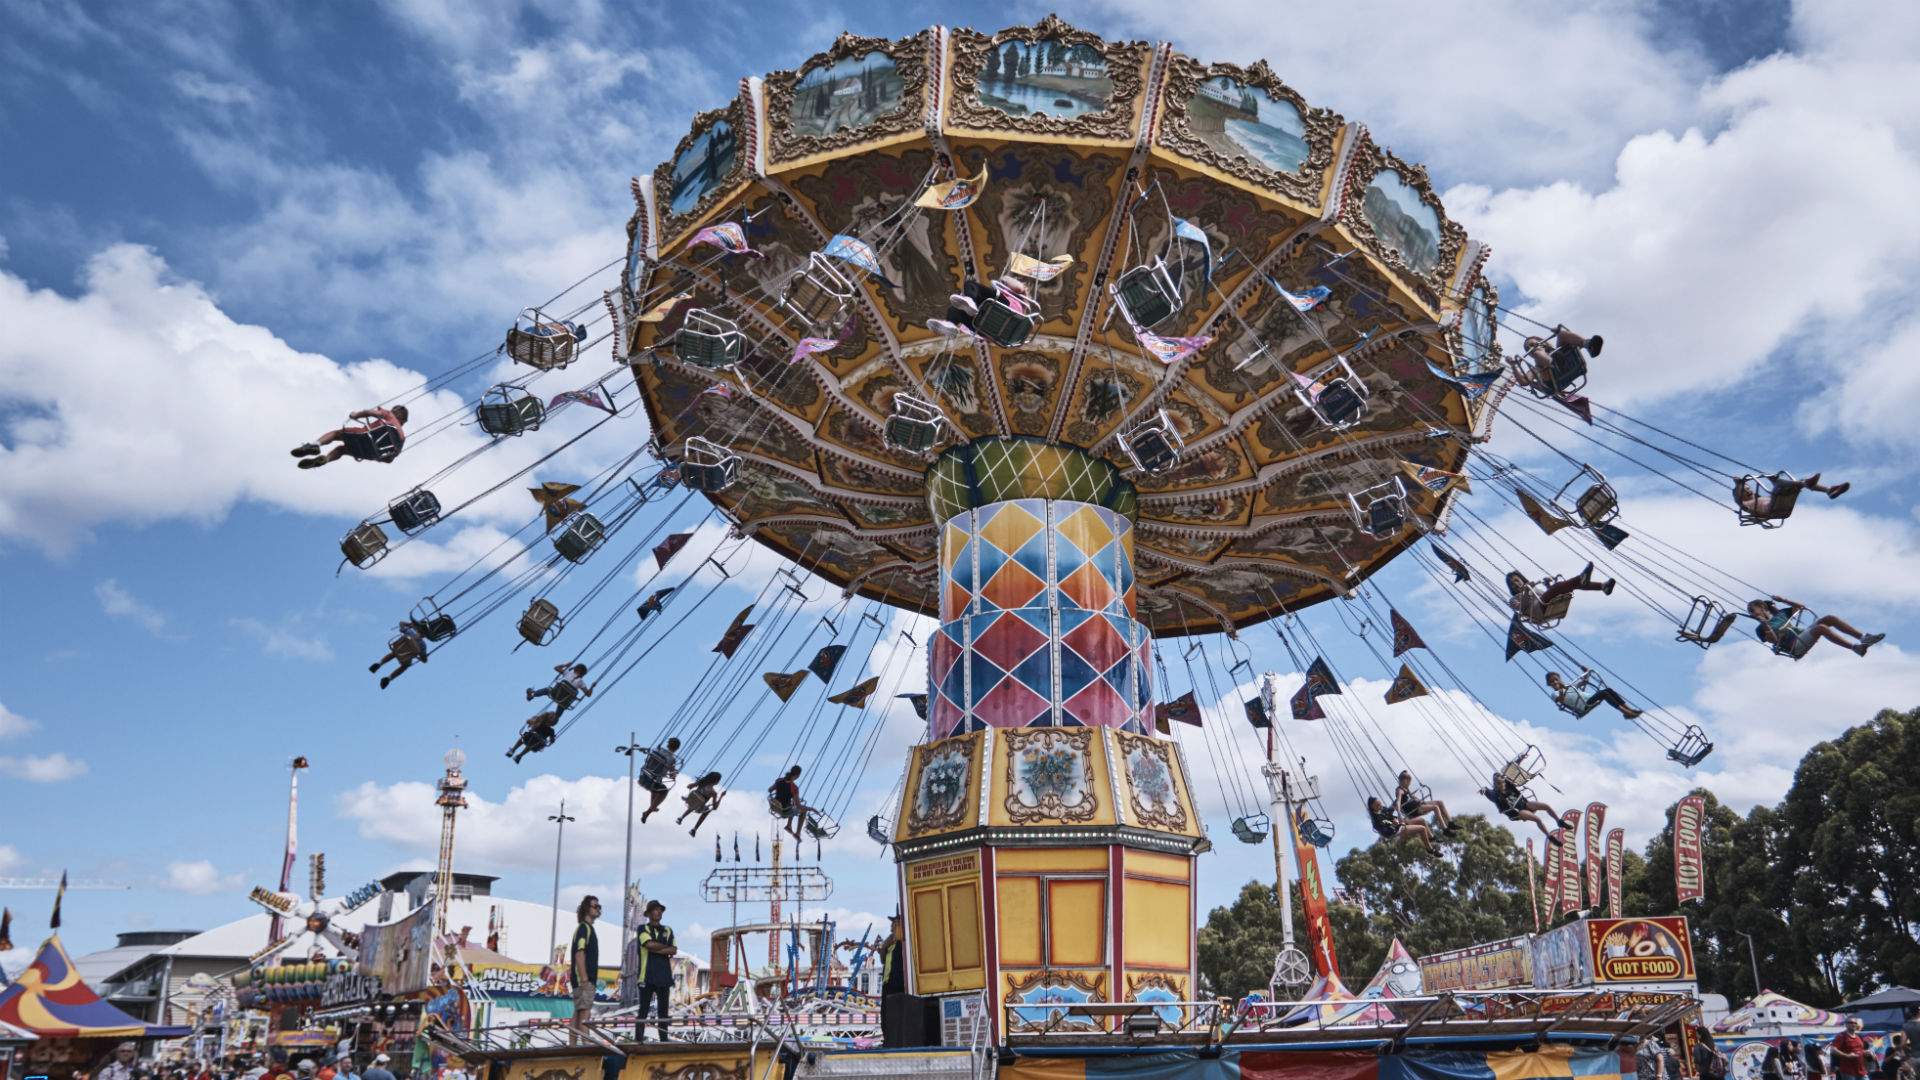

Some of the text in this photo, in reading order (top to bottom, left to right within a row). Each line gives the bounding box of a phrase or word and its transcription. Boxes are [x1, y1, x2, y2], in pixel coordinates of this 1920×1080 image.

[1589, 812, 1601, 858] FOOD
[1679, 805, 1699, 890] HOT FOOD
[1609, 839, 1620, 880] FOOD
[1563, 866, 1579, 902] HOT
[483, 968, 532, 983] MUSIK
[1613, 960, 1674, 975] HOT FOOD
[479, 980, 539, 992] EXPRESS
